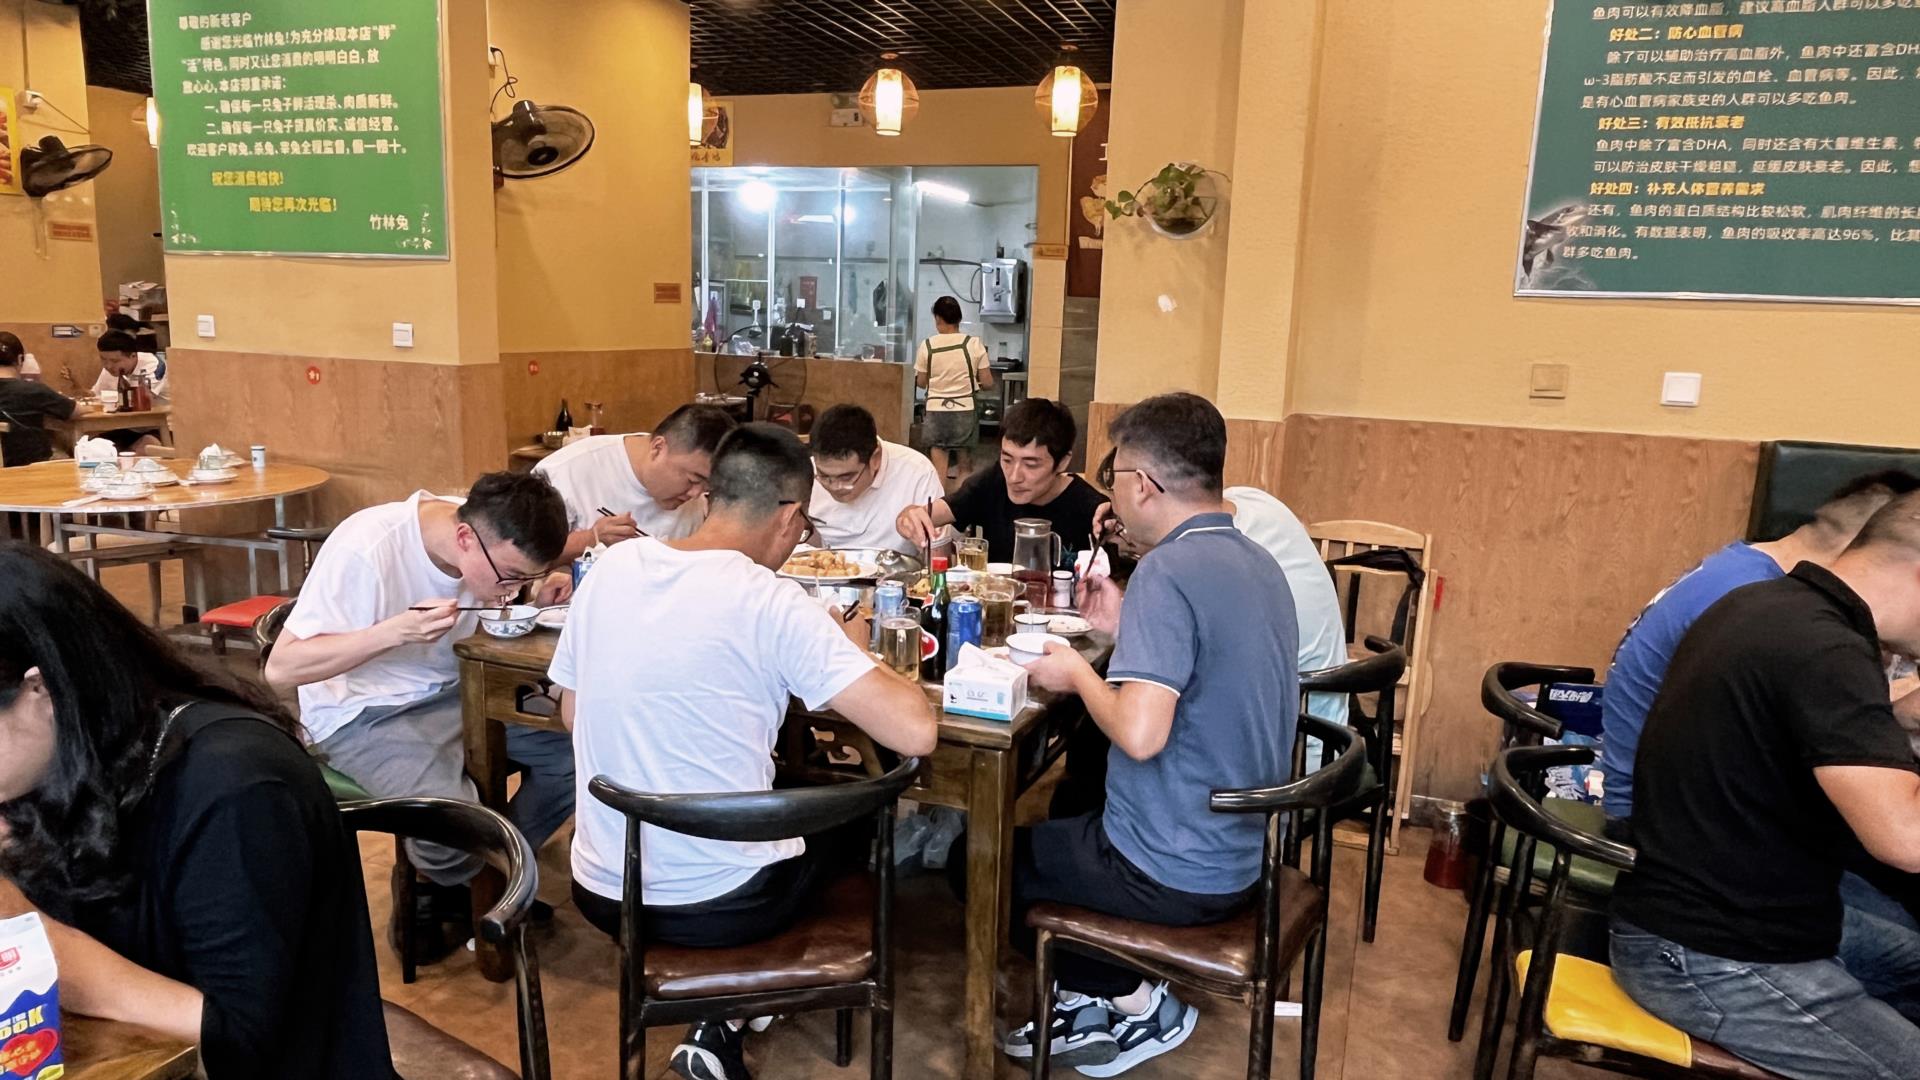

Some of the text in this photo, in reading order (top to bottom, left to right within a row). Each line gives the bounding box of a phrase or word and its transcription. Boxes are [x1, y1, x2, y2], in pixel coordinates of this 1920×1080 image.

[1593, 0, 1920, 19] 鱼肉可以有效降血脂，建议高血脂人群可以多吃
[1607, 43, 1920, 64] 除了可以辅助治疗高血脂外，鱼肉中还富含DH
[1587, 203, 1920, 219] 还有，鱼肉的蛋白质结构比较松软，肌肉纤维的长
[369, 214, 409, 230] 竹林兔
[1562, 246, 1640, 260] 群多吃鱼肉。
